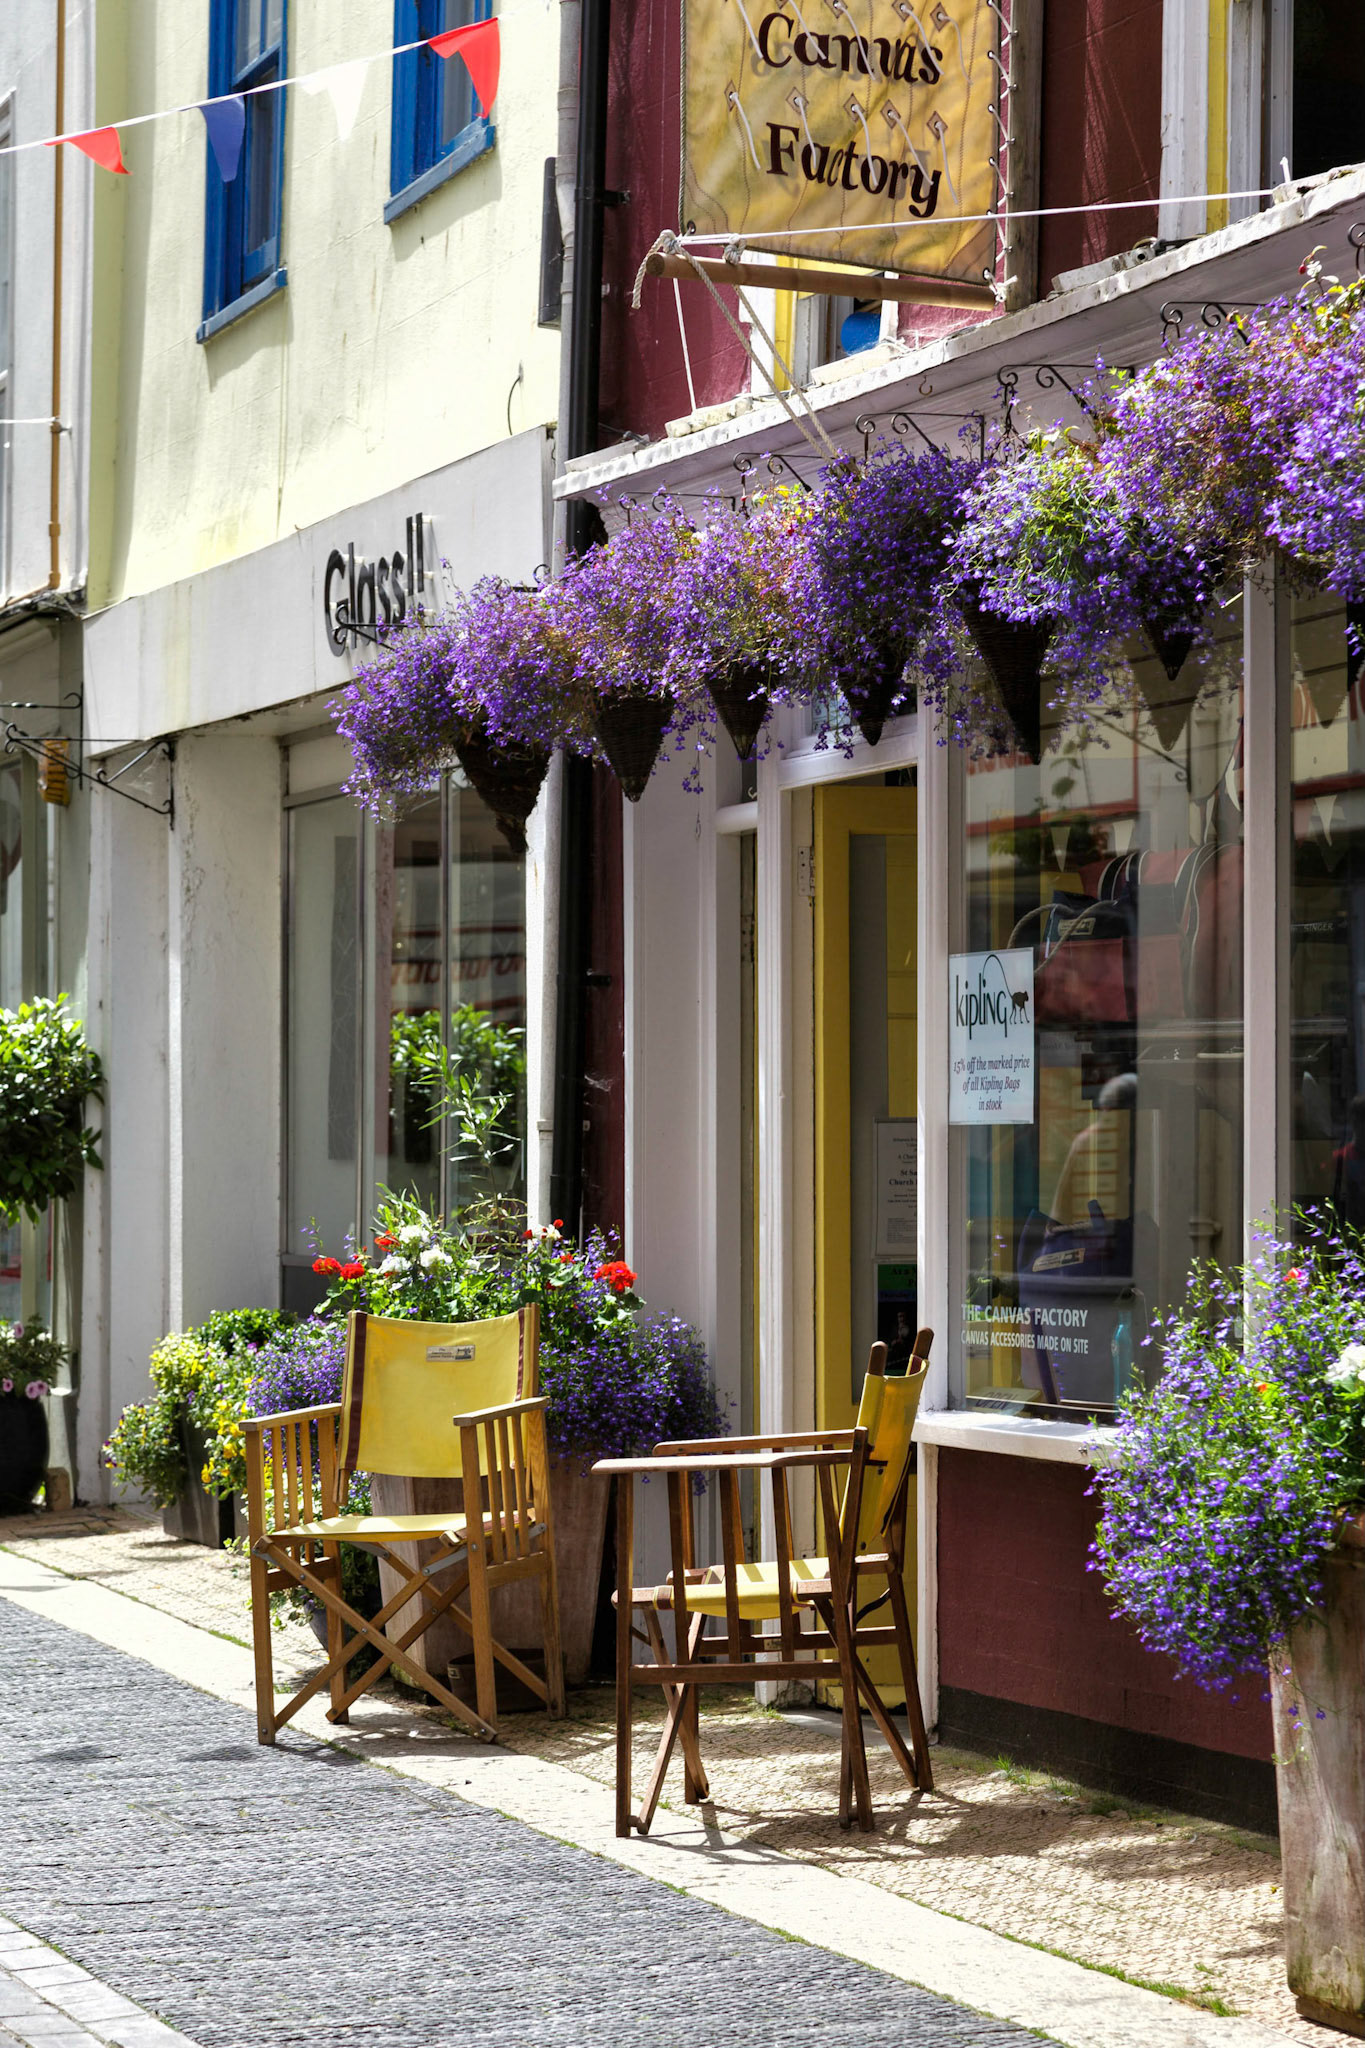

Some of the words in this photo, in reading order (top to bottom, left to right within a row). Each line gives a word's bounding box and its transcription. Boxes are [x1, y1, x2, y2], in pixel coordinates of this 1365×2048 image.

[758, 12, 943, 85] Canvas
[765, 122, 942, 218] Factory
[956, 972, 1008, 1040] kipling
[953, 1058, 966, 1075] 15%
[966, 1056, 977, 1074] off
[976, 1055, 987, 1071] the
[987, 1053, 1013, 1070] marked
[1013, 1053, 1031, 1072] price
[962, 1077, 971, 1094] of
[970, 1076, 980, 1091] all
[980, 1075, 1004, 1093] Kipling
[1004, 1075, 1021, 1093] Bags
[978, 1096, 985, 1111] in
[985, 1096, 1003, 1111] stock
[888, 1178, 914, 1186] Church
[961, 1303, 981, 1321] THE
[985, 1305, 1031, 1326] CANVAS
[1034, 1307, 1088, 1328] FACTORY
[961, 1330, 989, 1346] CANVAS
[990, 1332, 1035, 1349] ACCESSORIES
[1037, 1335, 1059, 1351] MADE
[1060, 1337, 1072, 1353] ON
[1073, 1338, 1089, 1354] SITE
